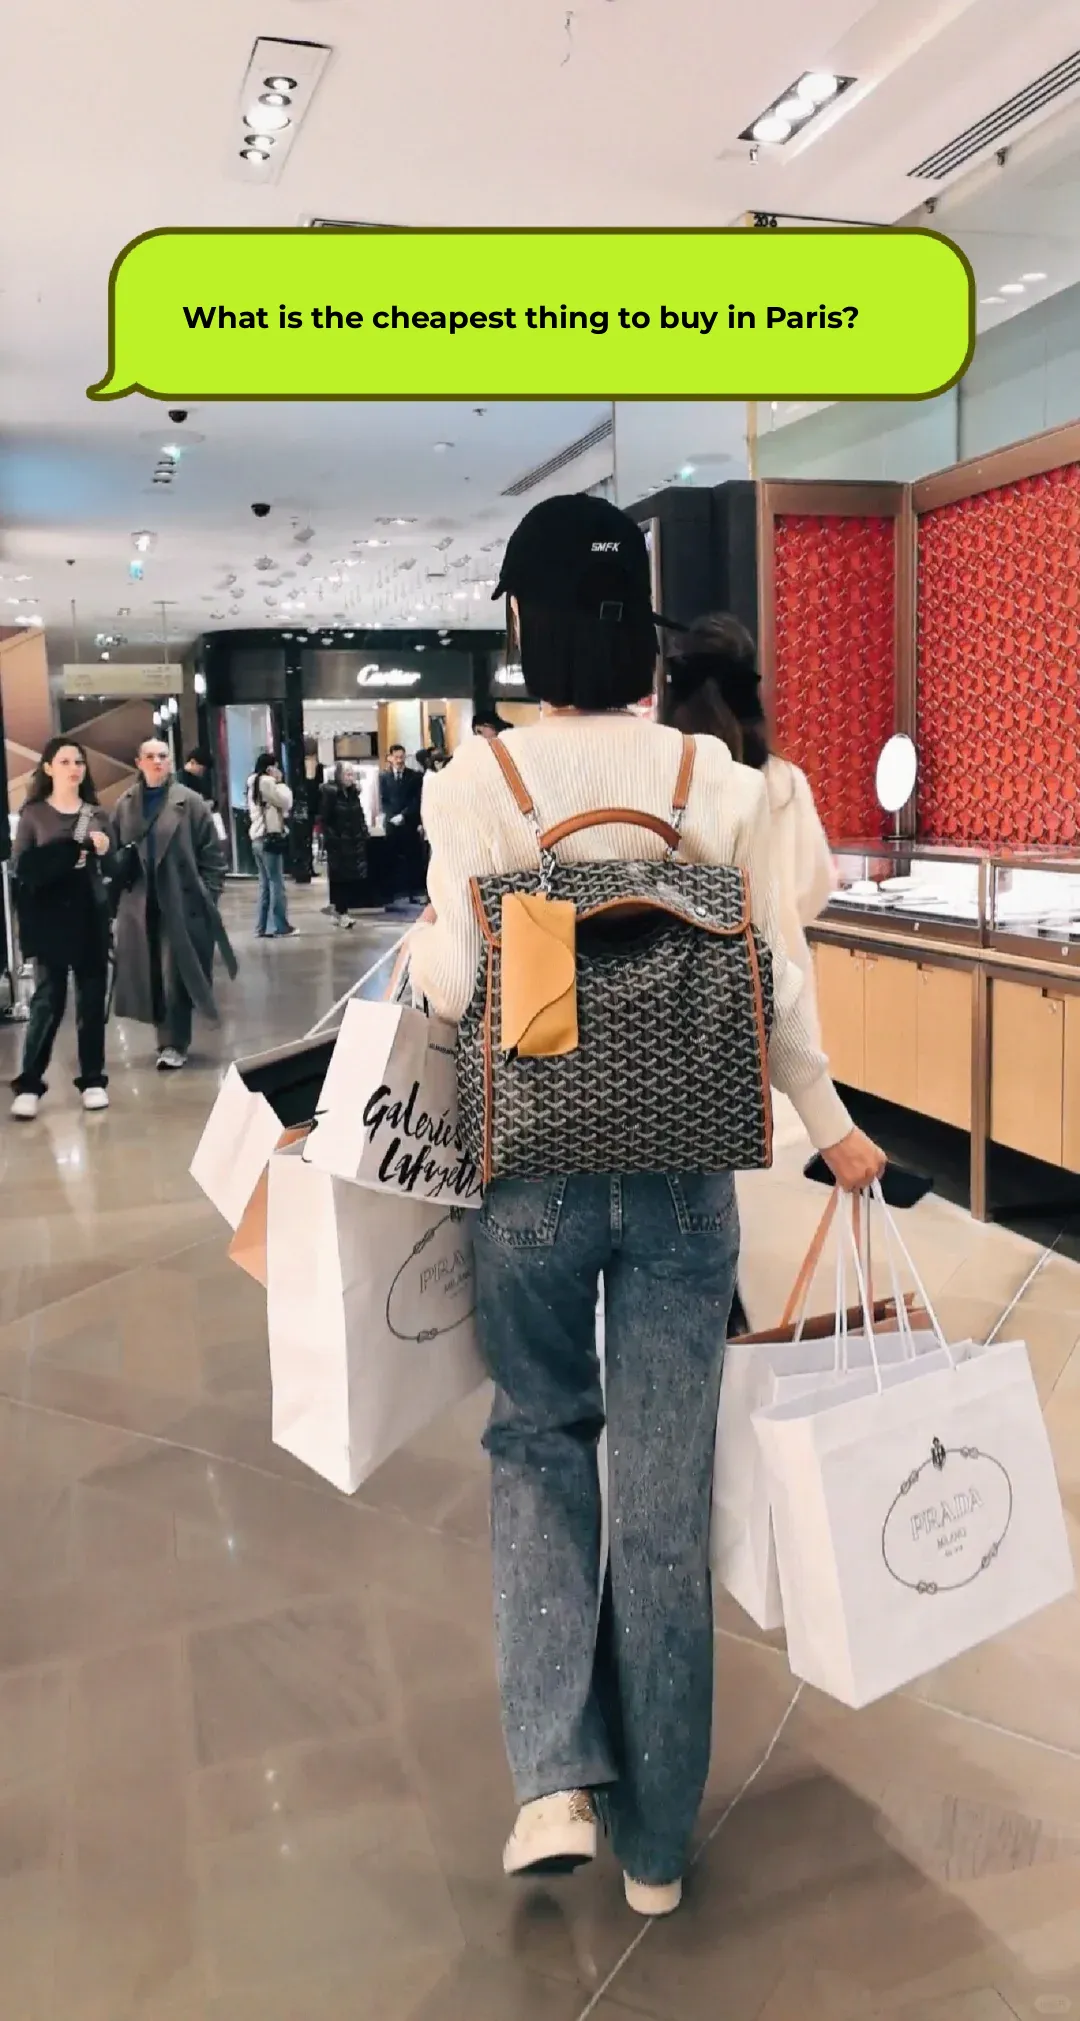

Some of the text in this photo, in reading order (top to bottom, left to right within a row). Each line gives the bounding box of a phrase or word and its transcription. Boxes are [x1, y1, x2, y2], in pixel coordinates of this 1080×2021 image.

[591, 541, 620, 552] SMFK
[356, 663, 422, 687] Cartier
[363, 1080, 462, 1152] Galeries
[420, 1249, 466, 1294] PRA
[910, 1485, 984, 1541] PRADA
